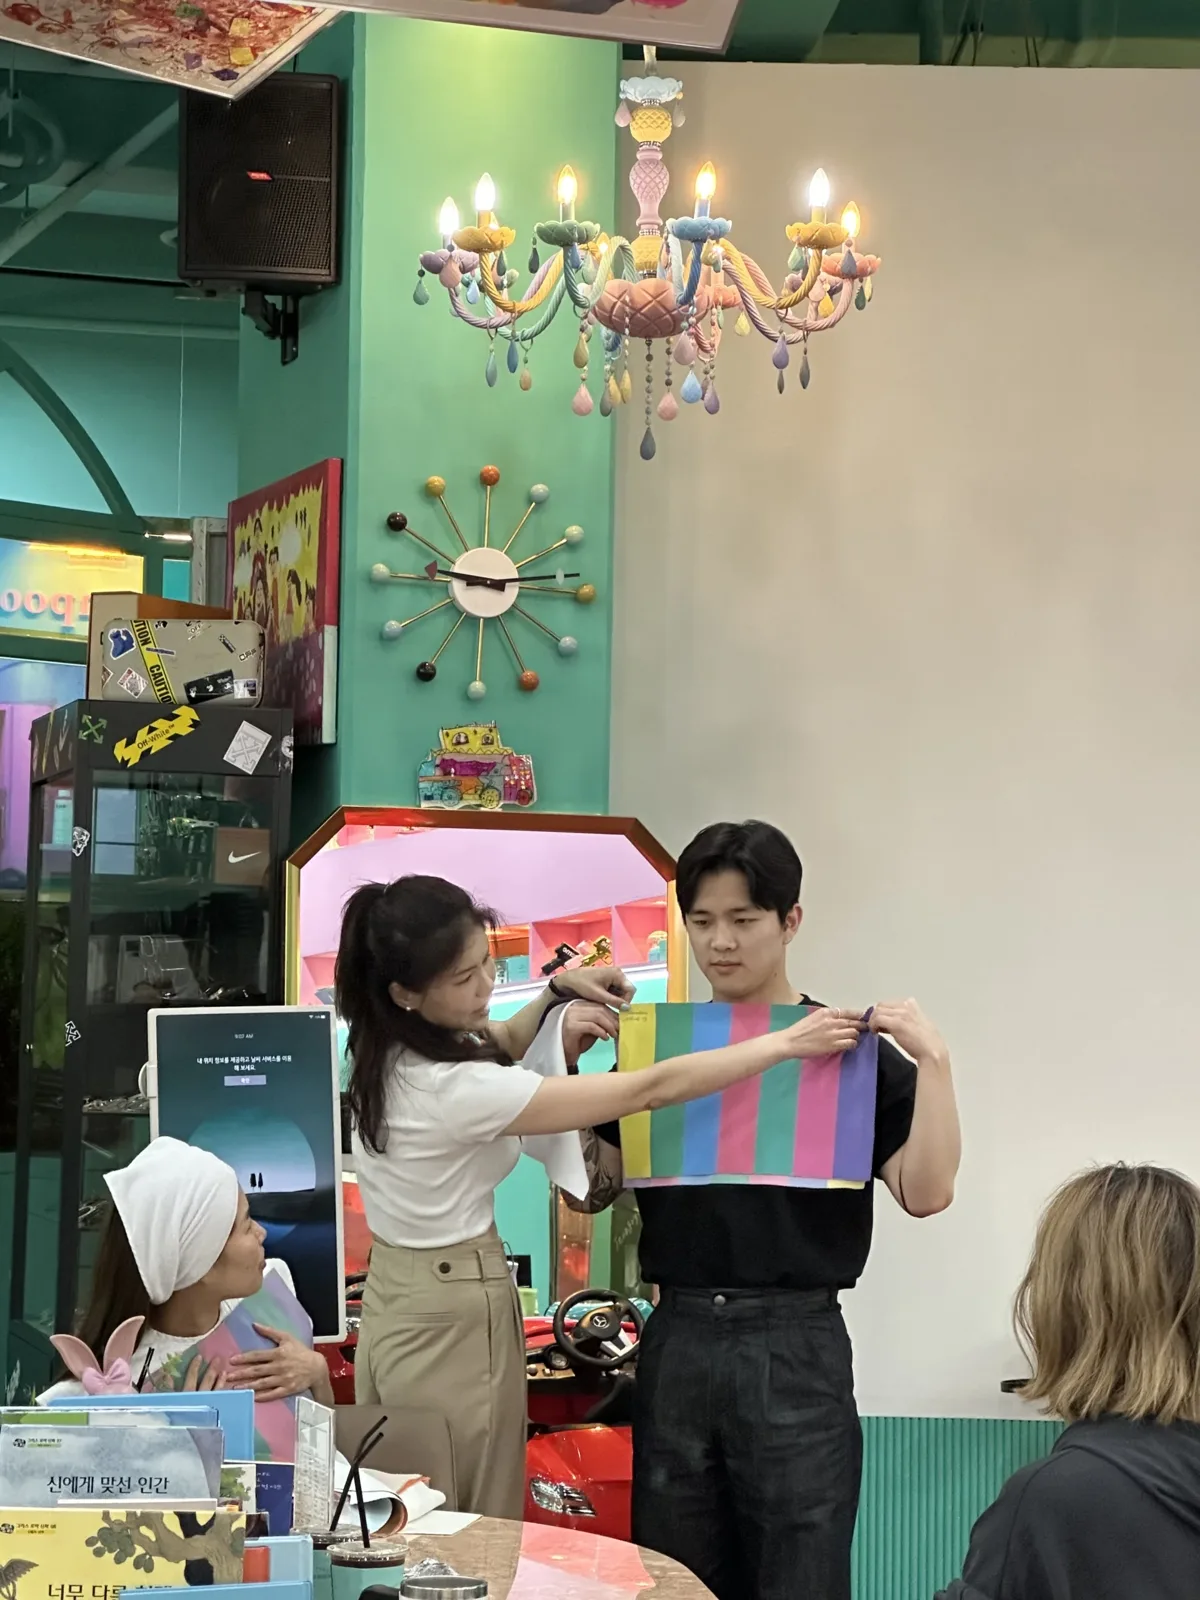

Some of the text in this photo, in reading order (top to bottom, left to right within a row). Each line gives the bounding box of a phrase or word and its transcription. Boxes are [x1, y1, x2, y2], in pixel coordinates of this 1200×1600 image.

[149, 664, 174, 705] CAUTIO
[230, 1056, 250, 1064] 제공하고
[262, 1055, 281, 1063] 서비스를
[47, 1476, 170, 1494] 신에게 맞선 인간
[48, 1584, 84, 1600] 너무
